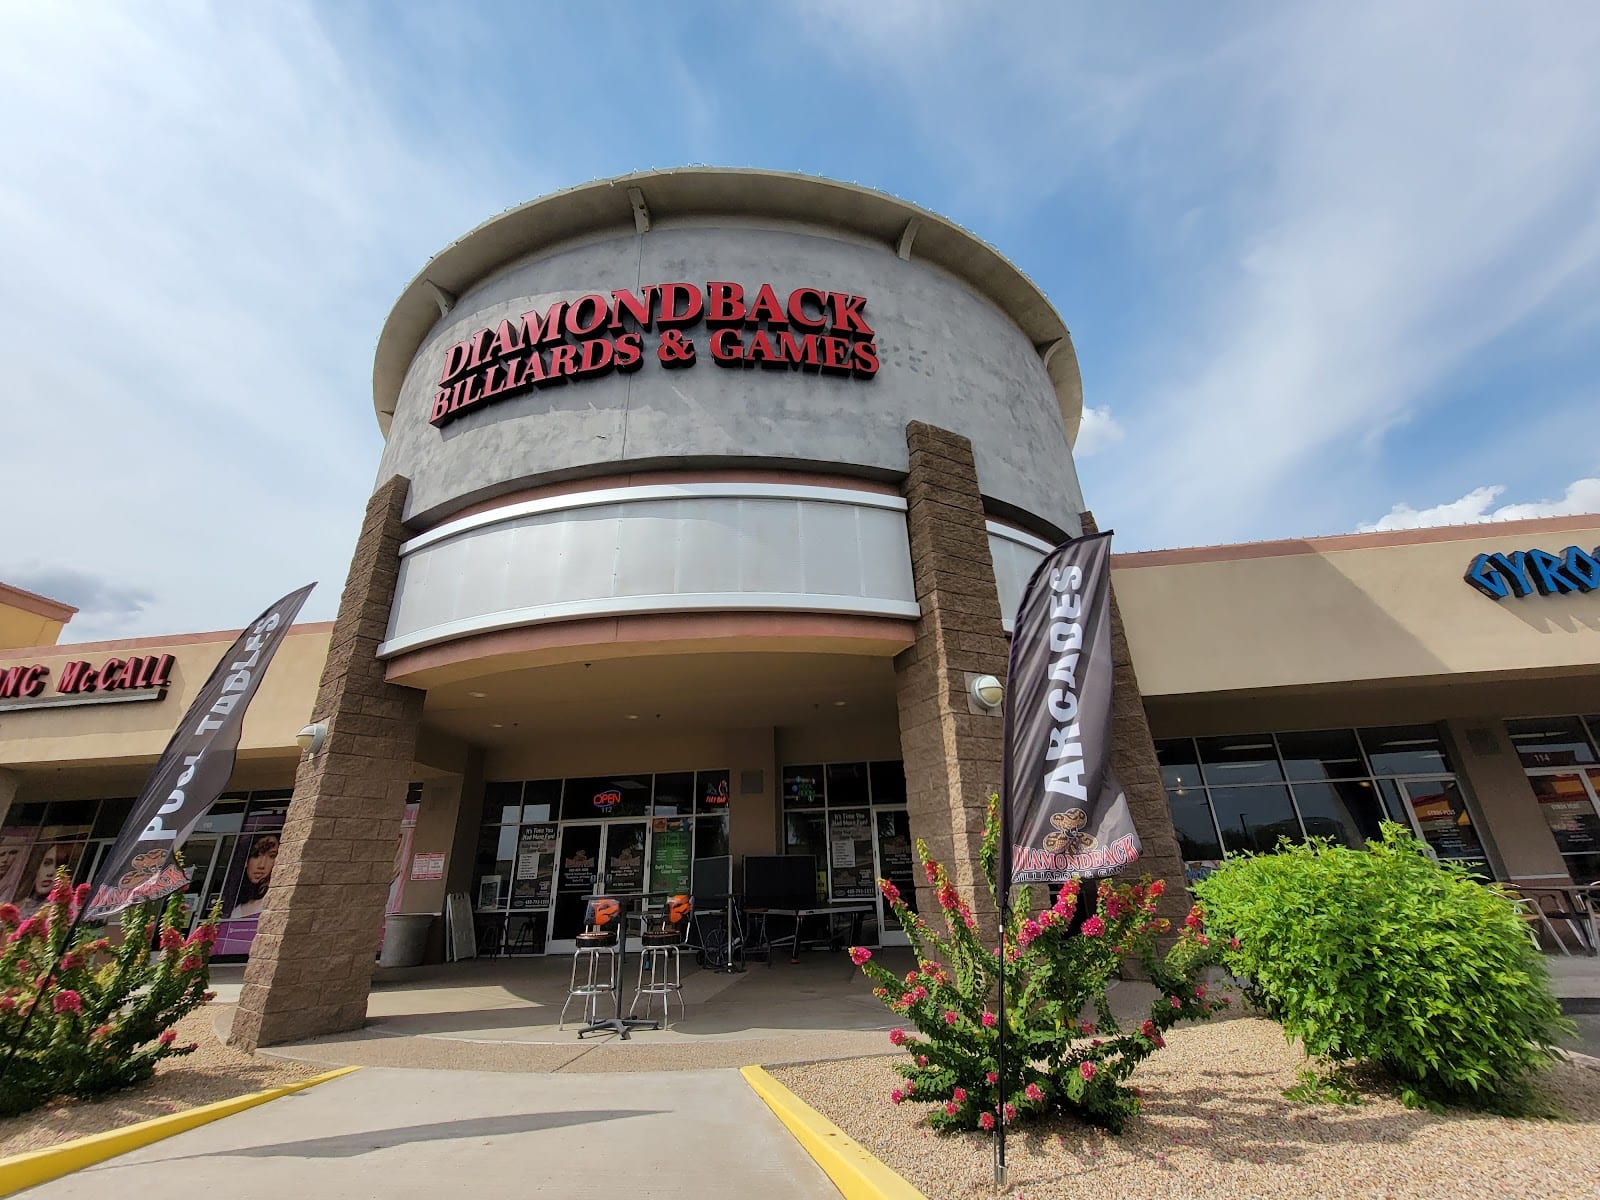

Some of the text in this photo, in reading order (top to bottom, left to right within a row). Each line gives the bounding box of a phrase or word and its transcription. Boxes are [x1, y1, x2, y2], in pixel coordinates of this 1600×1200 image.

[440, 281, 875, 385] DIAMONDBACK
[429, 328, 880, 427] BILLIARDS & GAMES
[0, 664, 50, 697] NG
[195, 611, 281, 736] TABLES
[1044, 565, 1088, 802] ARCADES
[1533, 753, 1551, 762] 114
[592, 793, 621, 806] OPEN
[1012, 834, 1140, 873] DIAMONDBACK
